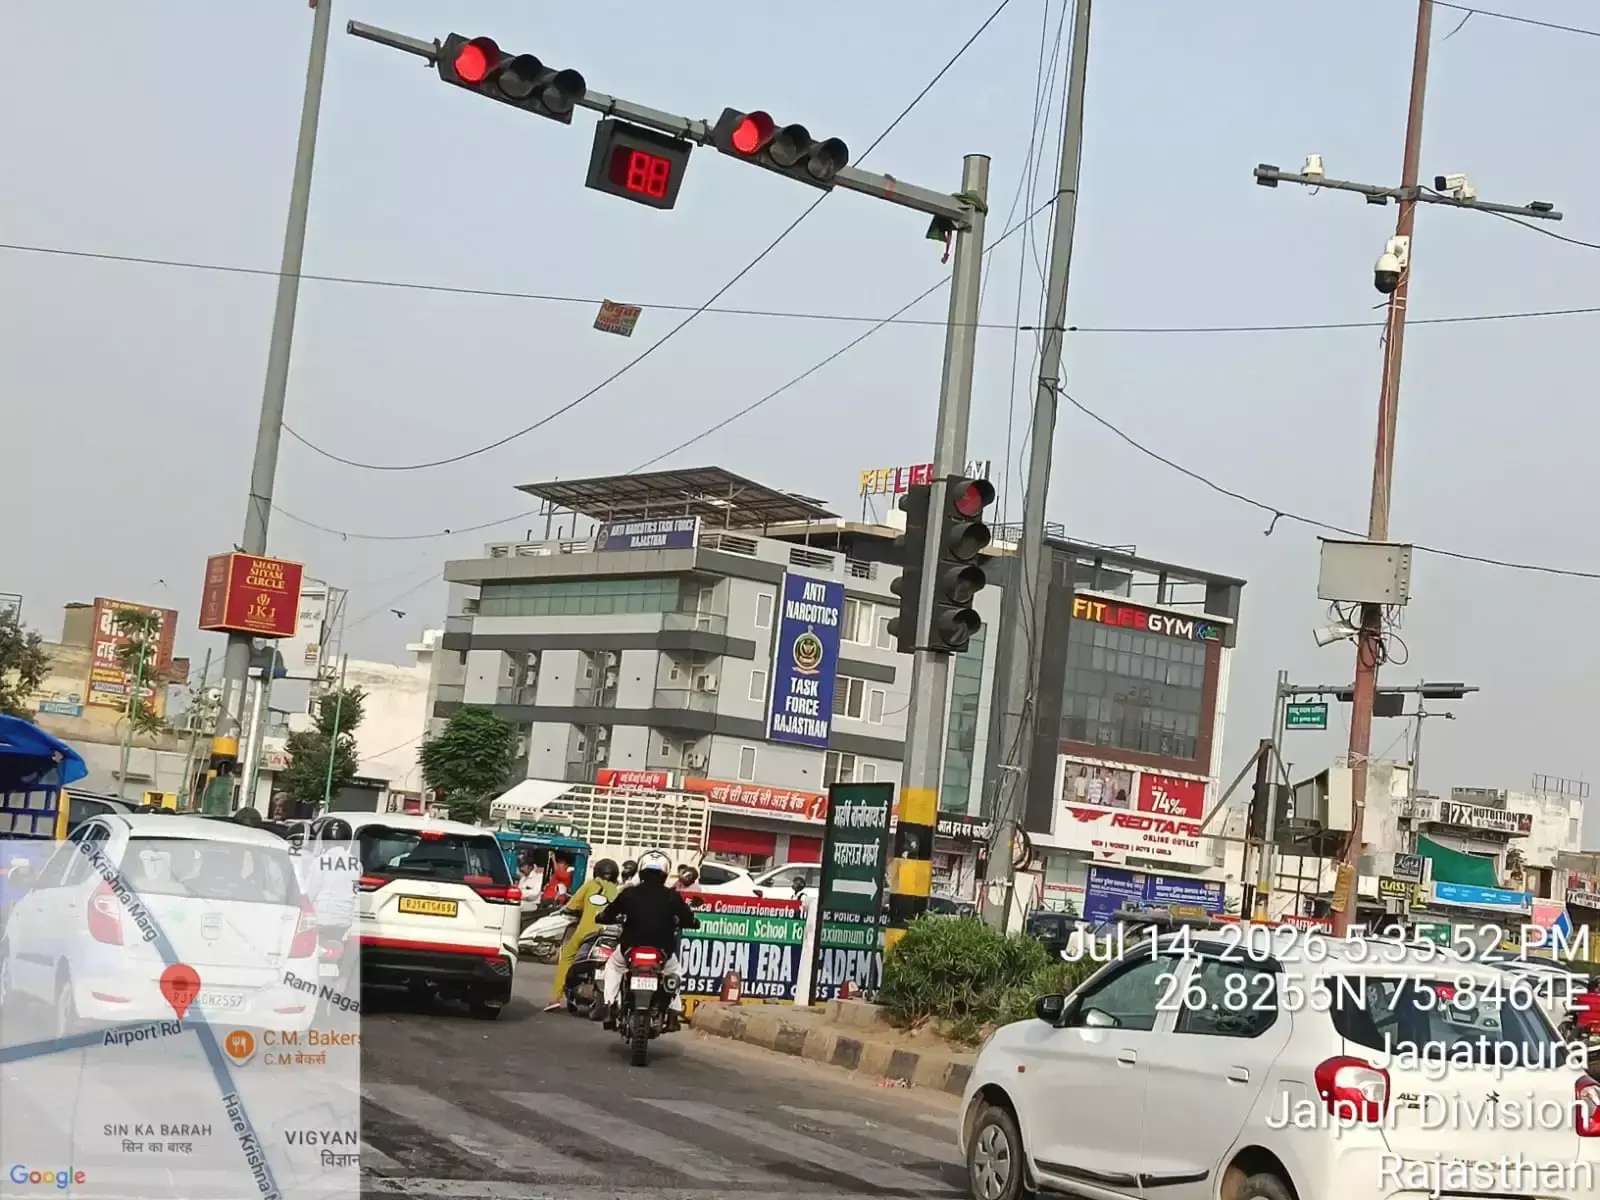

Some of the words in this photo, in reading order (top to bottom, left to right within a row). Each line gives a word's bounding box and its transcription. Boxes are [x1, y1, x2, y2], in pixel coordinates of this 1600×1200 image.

[250, 568, 284, 581] SHYAM
[252, 560, 284, 571] KHATU
[246, 576, 286, 590] CIRCLE
[802, 581, 826, 603] ANTI
[786, 600, 838, 626] NARCOTICS
[1072, 598, 1108, 622] FIT
[1148, 613, 1194, 640] GYM
[790, 677, 819, 697] TASK
[785, 695, 820, 717] FORCE
[773, 713, 828, 739] RAJASTHAN
[1151, 789, 1181, 815] 74%
[1110, 813, 1204, 837] REDTAPE
[1172, 836, 1199, 849] OUTLET
[754, 920, 788, 939] School
[680, 938, 750, 979] GOLDEN
[756, 943, 793, 982] ERA
